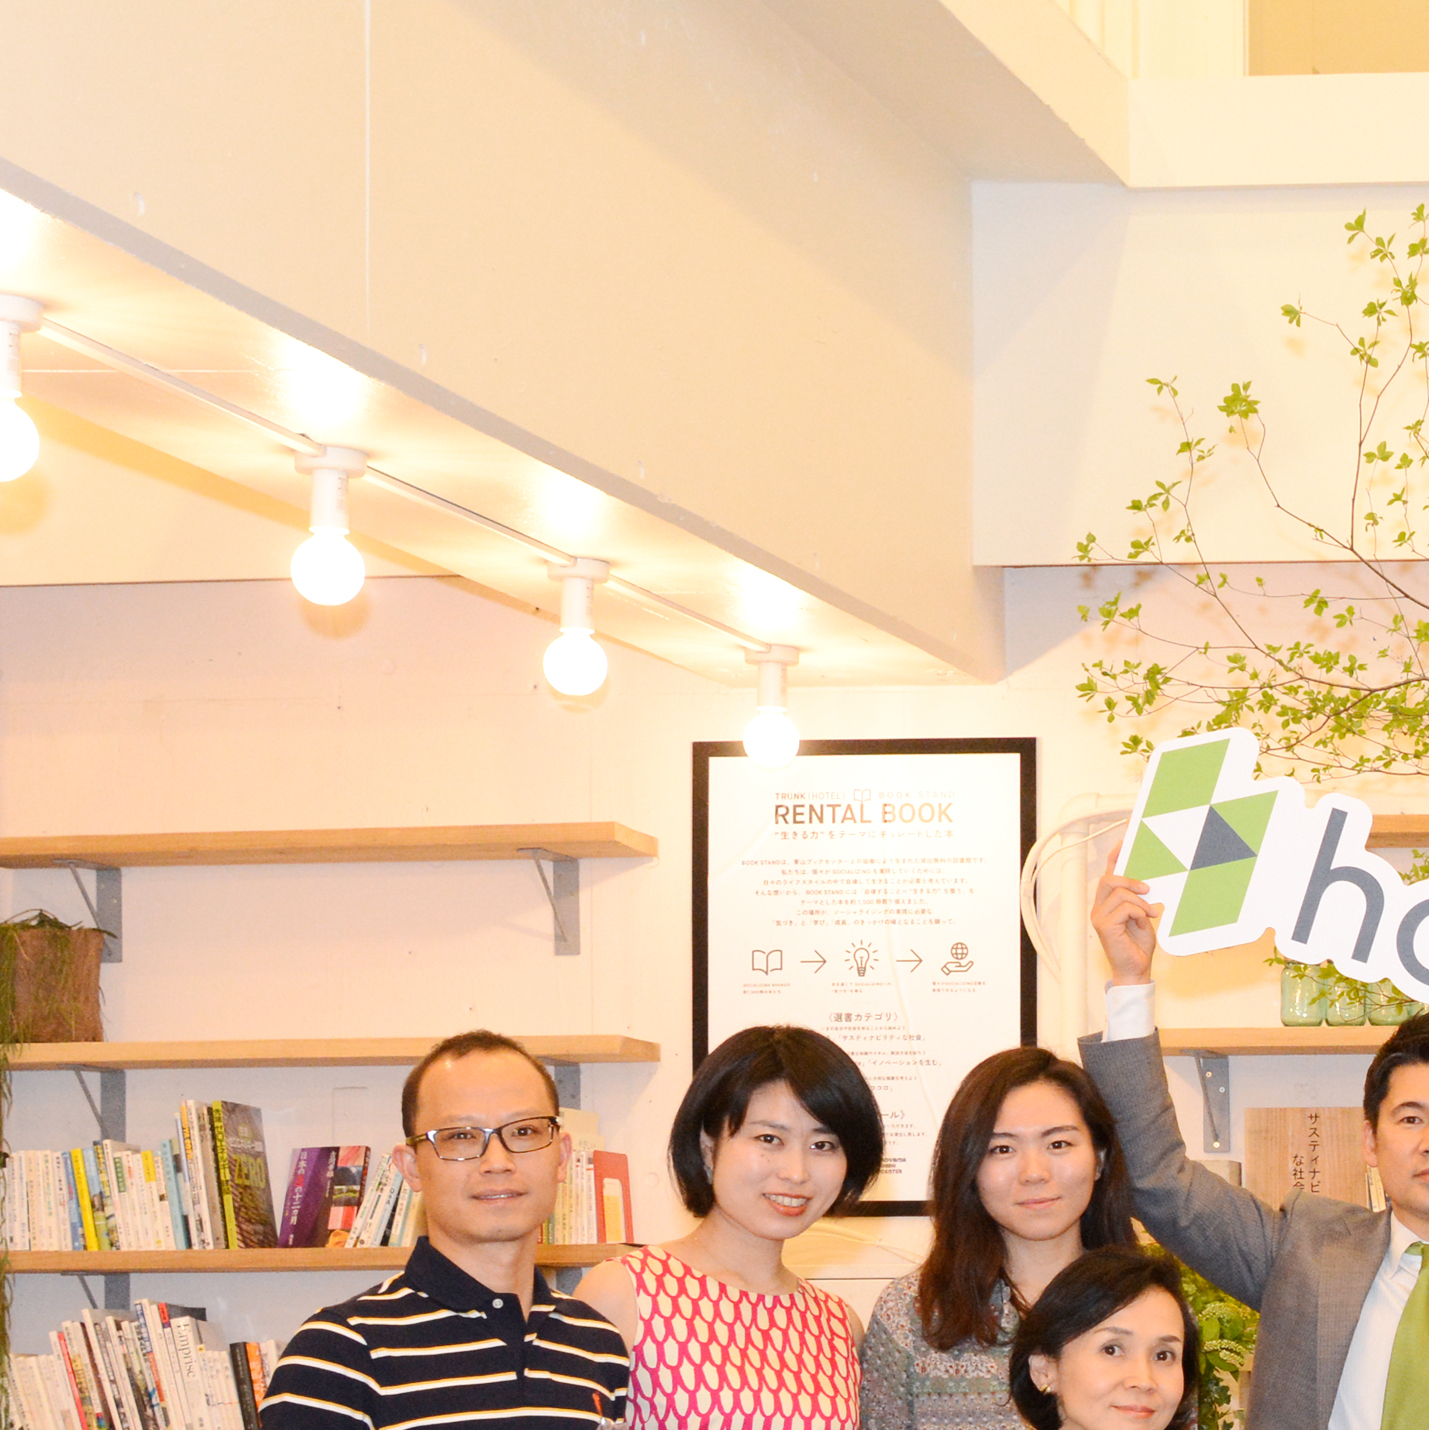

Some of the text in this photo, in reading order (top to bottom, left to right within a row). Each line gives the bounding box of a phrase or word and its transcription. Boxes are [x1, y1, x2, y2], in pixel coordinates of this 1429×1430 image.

[774, 802, 954, 824] RENTAL BOOK
[878, 791, 912, 799] BOOK
[1307, 1112, 1321, 1194] サスティナビ
[177, 1321, 196, 1379] Emprise
